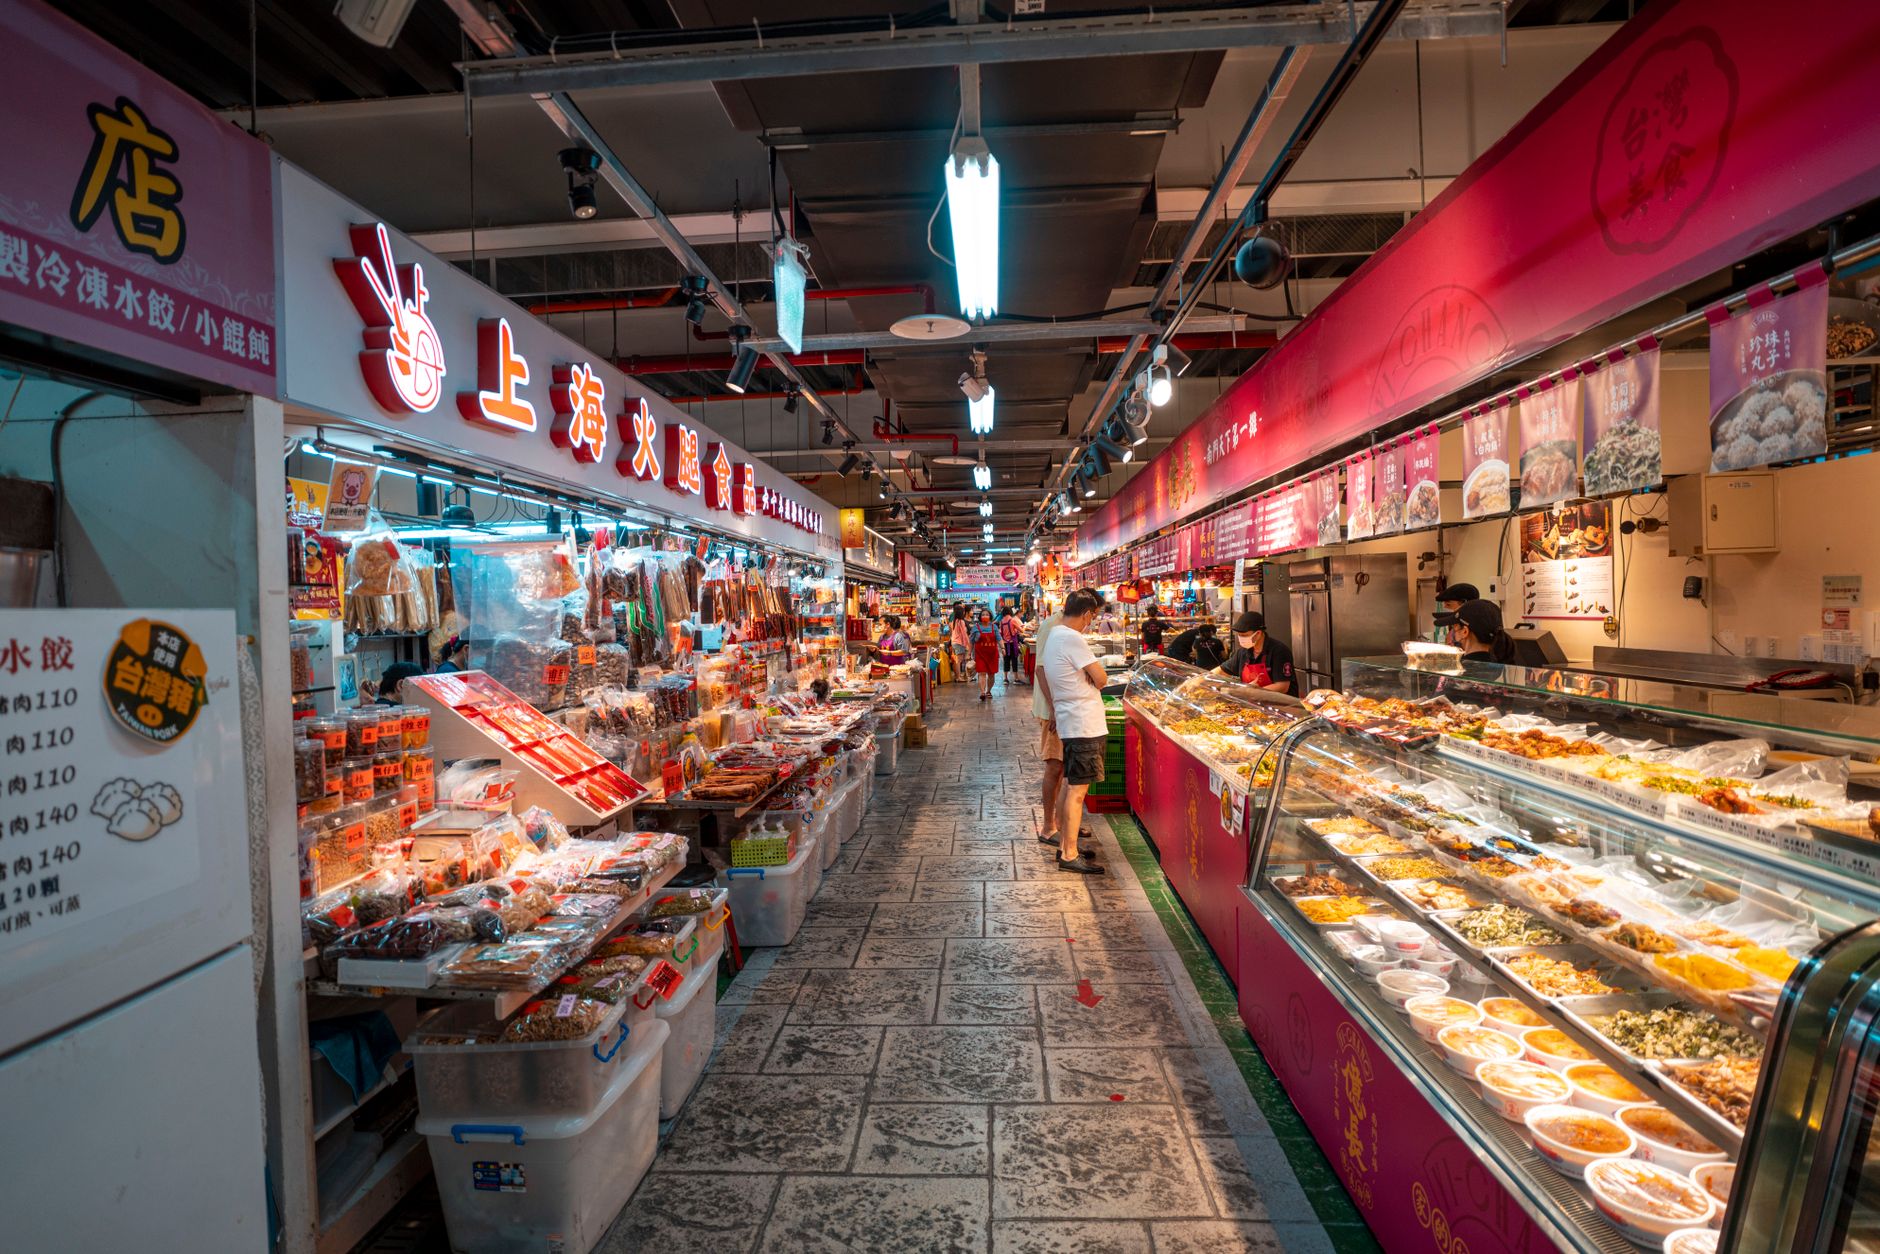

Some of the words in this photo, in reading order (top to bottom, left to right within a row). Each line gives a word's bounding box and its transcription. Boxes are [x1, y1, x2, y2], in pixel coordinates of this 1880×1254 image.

[70, 97, 187, 264] 店
[479, 318, 757, 517] 上海火腿食品
[158, 631, 180, 652] 本店
[153, 646, 176, 668] 使用
[35, 687, 78, 710] 110
[113, 655, 194, 716] 台灣豬
[117, 702, 154, 737] TAIWAN
[153, 725, 178, 740] PORK
[31, 726, 74, 751] 110
[33, 765, 76, 790] 110
[34, 802, 78, 830] 140
[38, 841, 81, 869] 140
